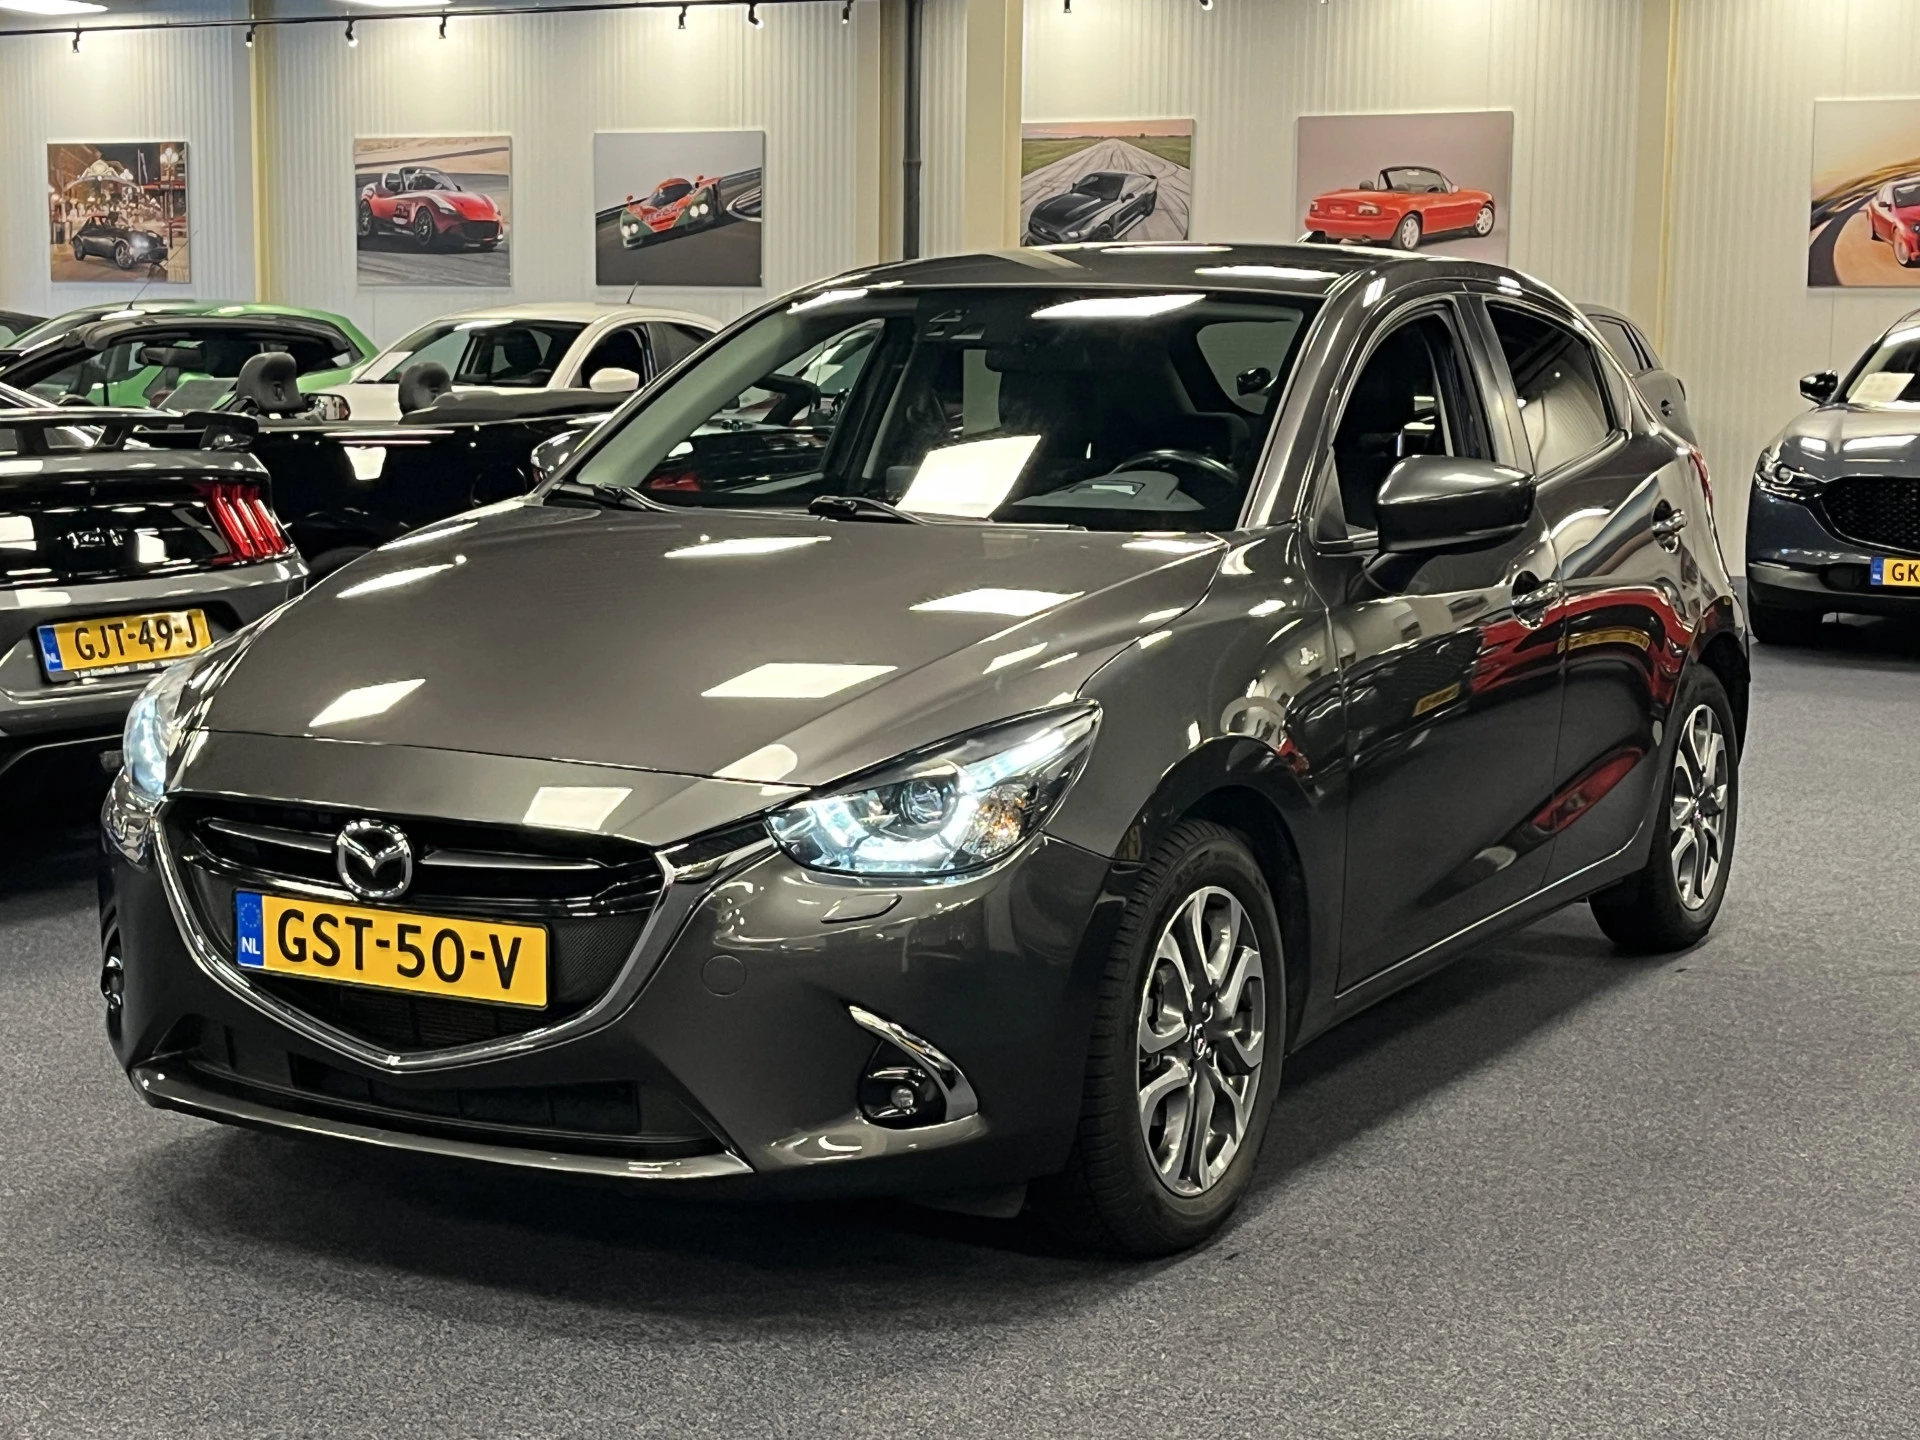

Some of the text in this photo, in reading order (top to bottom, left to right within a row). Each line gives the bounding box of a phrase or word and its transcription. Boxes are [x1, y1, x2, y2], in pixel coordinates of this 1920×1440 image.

[75, 614, 198, 661] GJT-49-J
[241, 936, 261, 955] NL
[277, 908, 522, 990] GST-50-V
